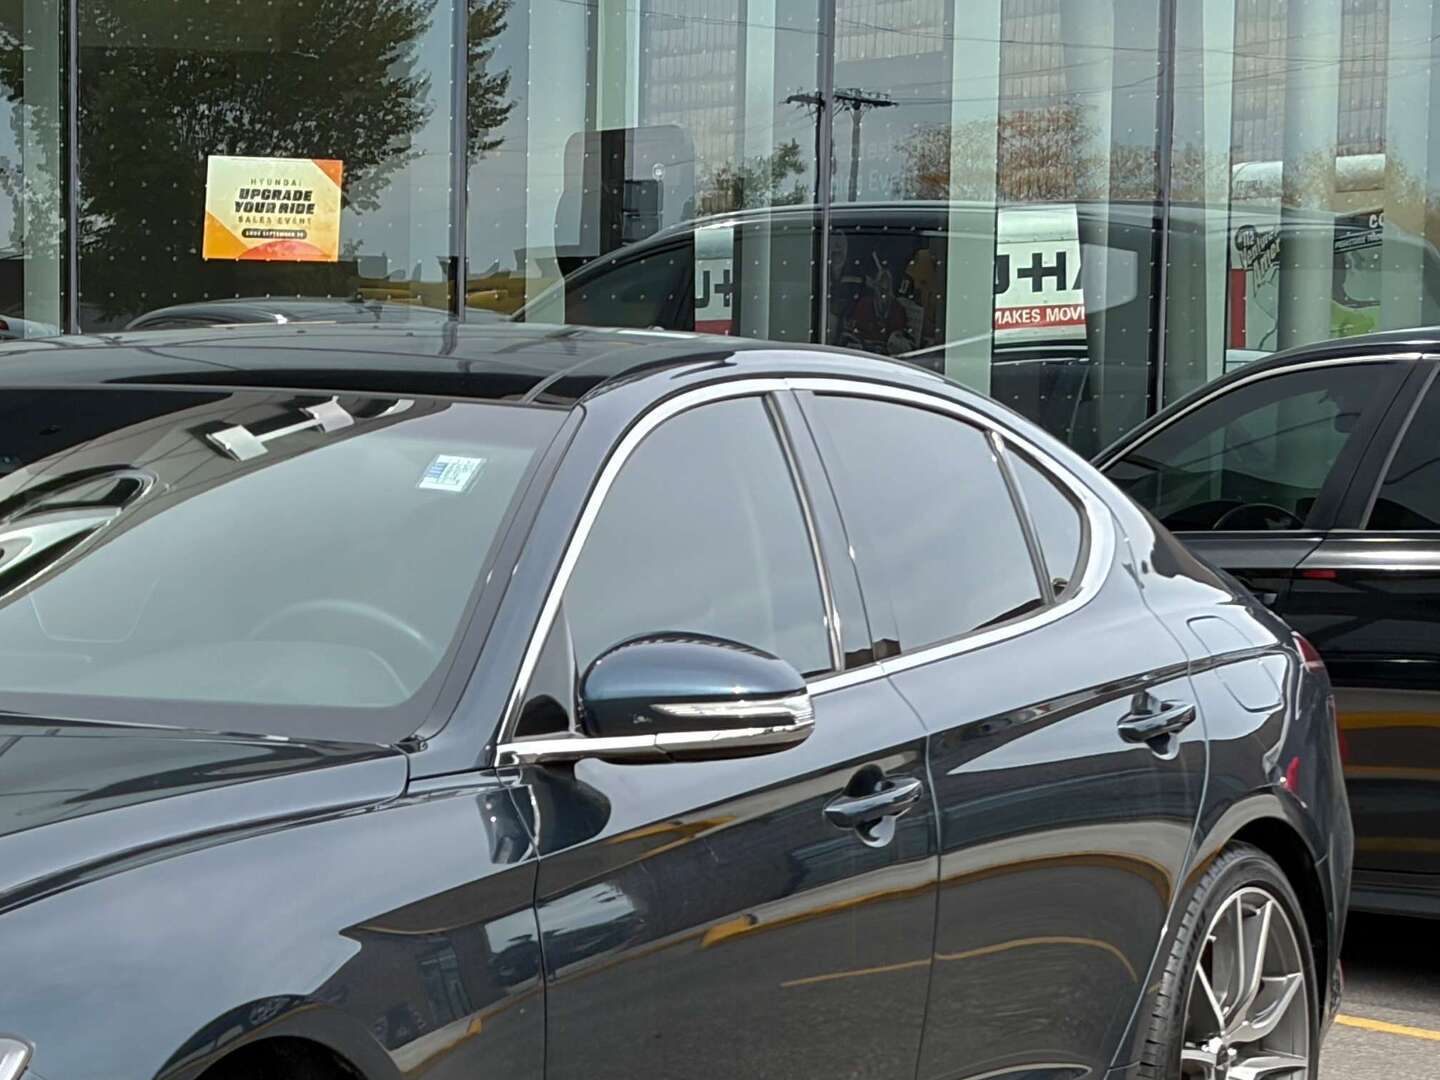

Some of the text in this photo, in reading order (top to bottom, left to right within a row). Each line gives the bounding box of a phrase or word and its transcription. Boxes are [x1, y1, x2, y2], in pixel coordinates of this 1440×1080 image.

[250, 178, 302, 186] HYUNDAI
[238, 188, 313, 201] UPGRADE
[234, 201, 316, 215] YOUR RIDE
[238, 216, 272, 225] SALES
